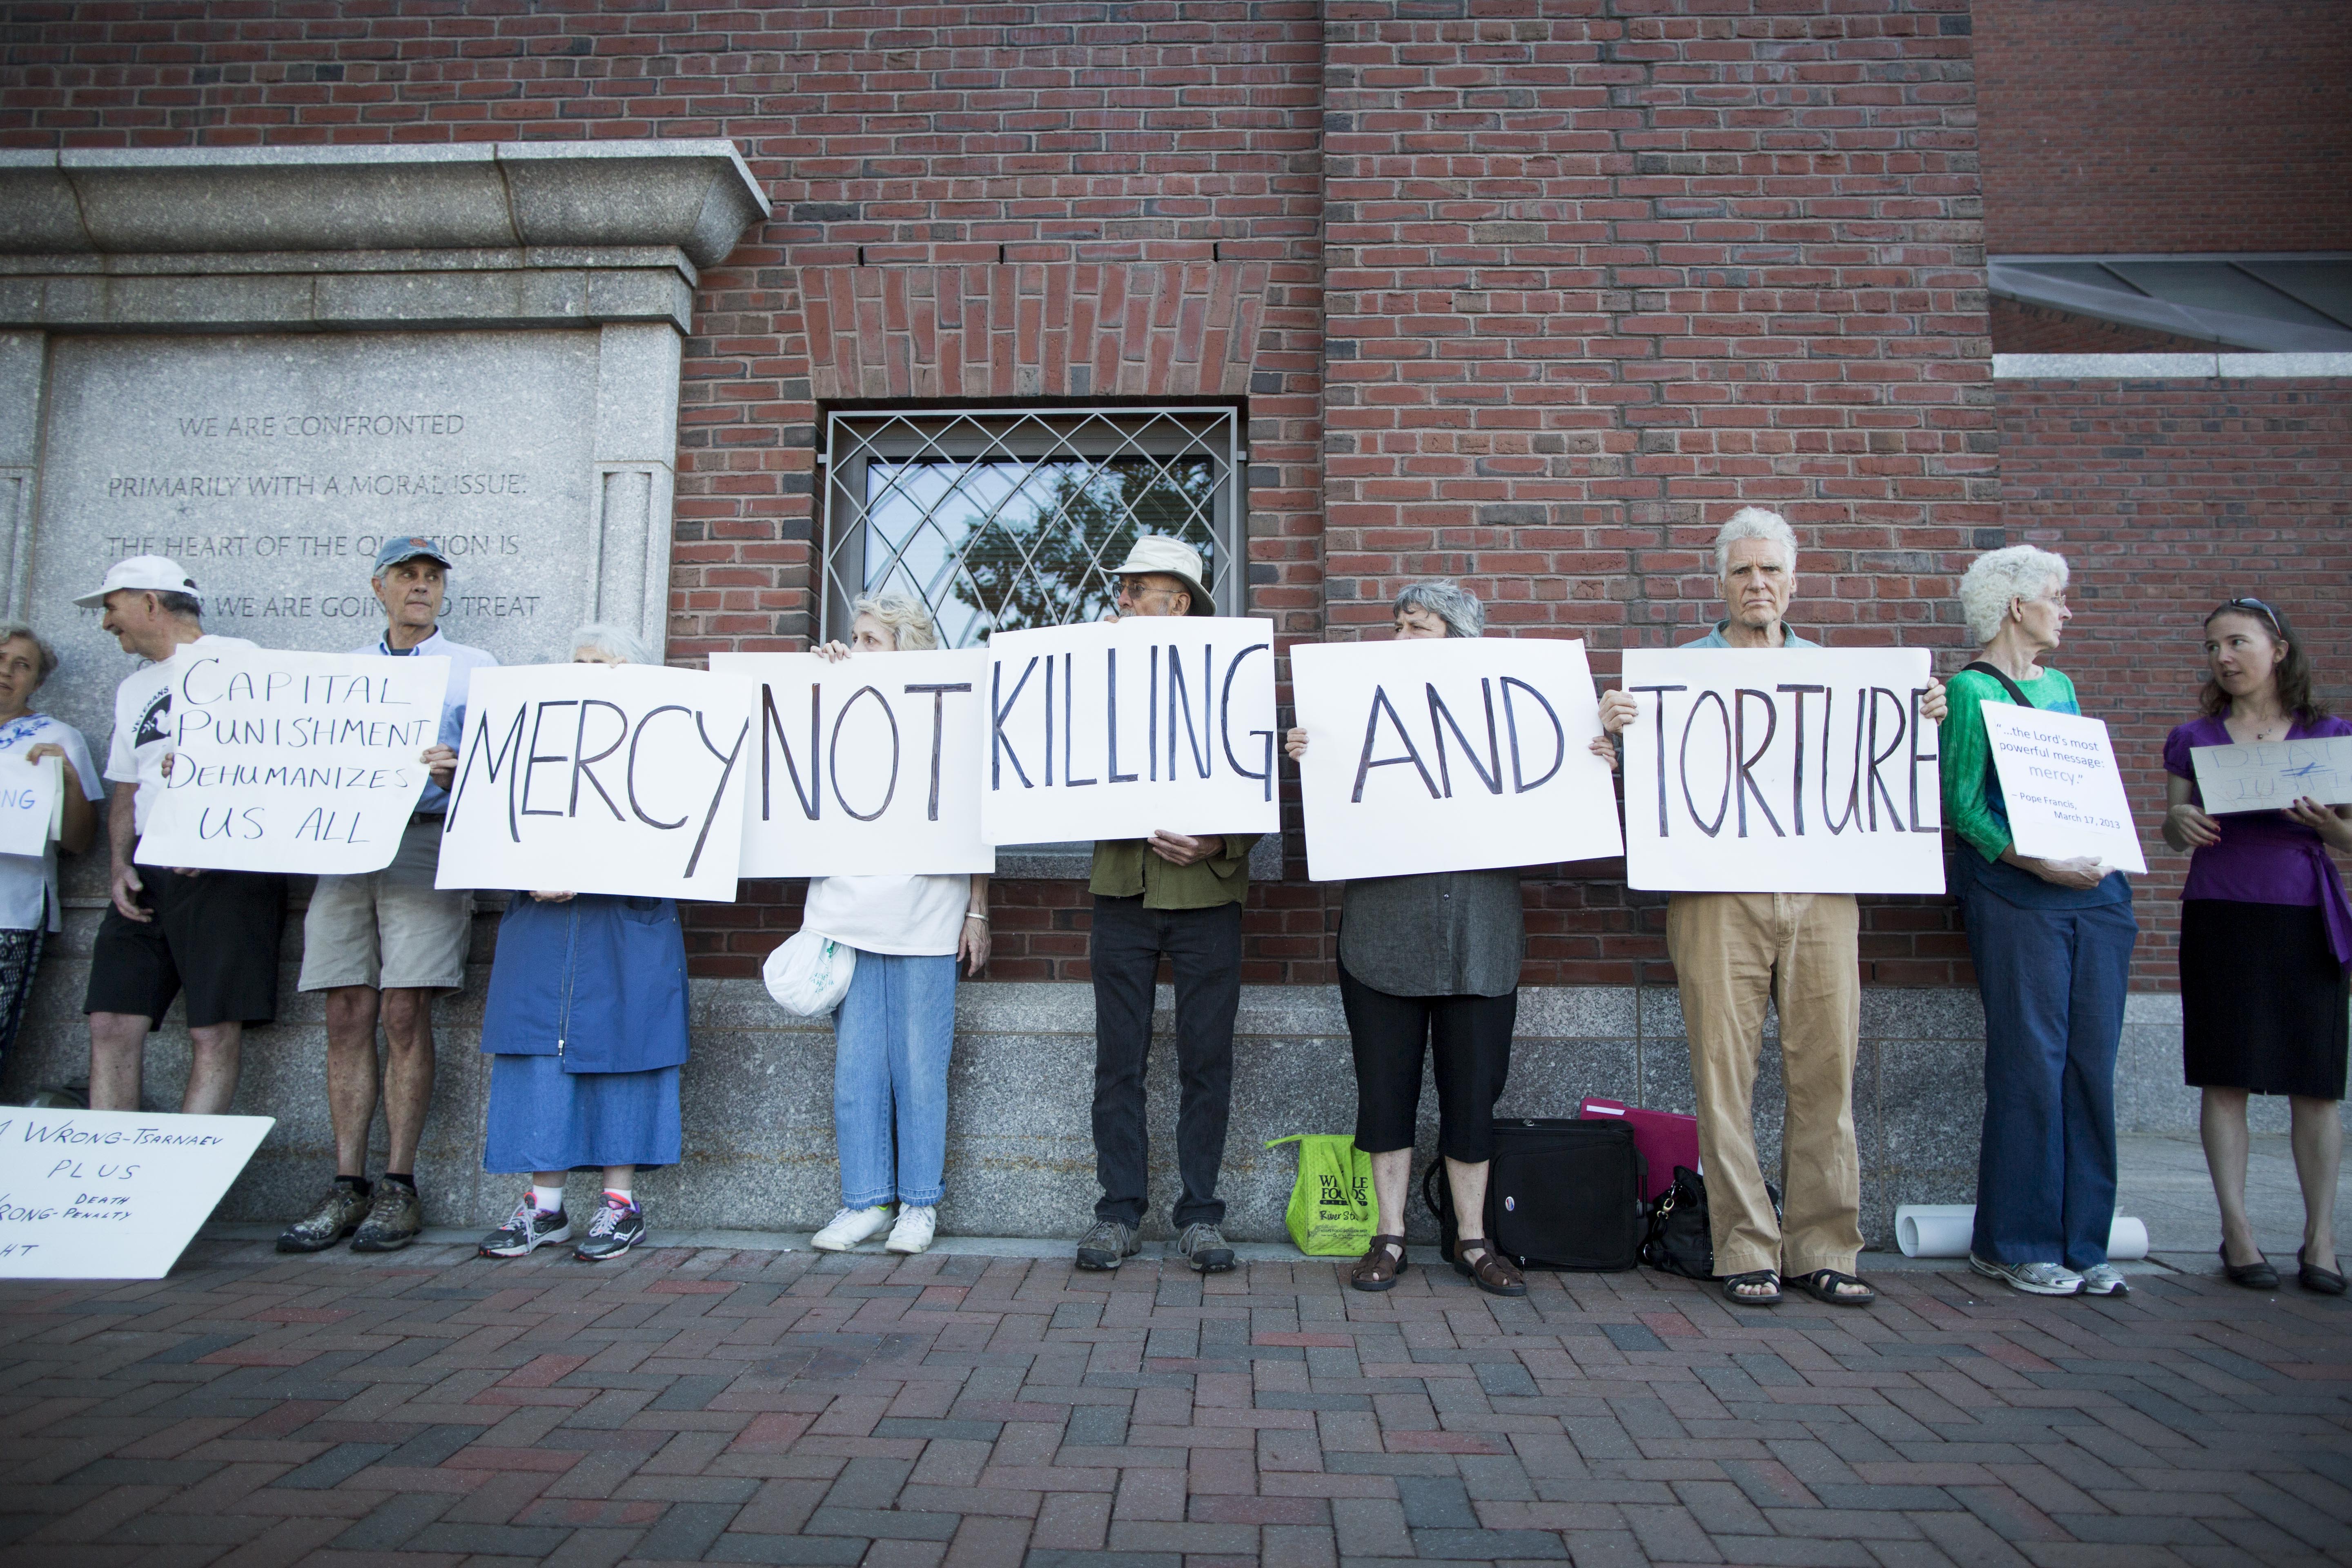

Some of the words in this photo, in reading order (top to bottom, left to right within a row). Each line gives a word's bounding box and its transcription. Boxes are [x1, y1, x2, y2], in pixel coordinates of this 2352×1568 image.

[179, 417, 218, 437] WE
[227, 417, 275, 437] ARE
[285, 414, 465, 436] CONFRONTED
[109, 477, 241, 497] PRIMARILY
[247, 476, 315, 496] WITH
[324, 476, 339, 495] A
[350, 475, 443, 495] MORAL
[453, 474, 527, 494] ISSUE.
[106, 537, 154, 557] THE
[165, 537, 249, 557] HEART
[256, 536, 291, 556] OF
[298, 536, 347, 556] THE
[357, 535, 489, 558] QTION
[500, 535, 519, 555] IS
[215, 597, 254, 617] WE
[263, 597, 313, 617] ARE
[321, 597, 387, 617] GOIN
[461, 596, 540, 617] TREAT
[182, 657, 412, 705] CAPITAL
[131, 686, 169, 733] VETERANS
[992, 644, 1274, 802] KILLING
[178, 709, 431, 748] PUNISHMENT
[1351, 676, 1564, 803] AND
[2033, 730, 2067, 746] Lord's
[2070, 739, 2099, 752] most
[762, 682, 972, 822] NOT
[1629, 684, 1940, 838] TORTURE
[1999, 742, 2049, 758] powerful
[2053, 751, 2105, 769] message:
[2212, 740, 2352, 768] DEAT
[167, 753, 408, 789] DEHUMANIZES
[446, 699, 750, 879] MERCY
[2020, 792, 2042, 804] Pope
[2043, 796, 2077, 811] Francis,
[199, 807, 265, 840] US
[295, 807, 370, 844] ALL
[2054, 810, 2082, 822] March
[2099, 818, 2120, 829] 2013
[47, 1159, 141, 1180] PLUS
[1319, 1174, 1368, 1189] WLE
[0, 1193, 58, 1222] RONG-
[62, 1207, 132, 1221] PENALTY
[74, 1193, 131, 1205] DEATH
[1319, 1210, 1342, 1221] River
